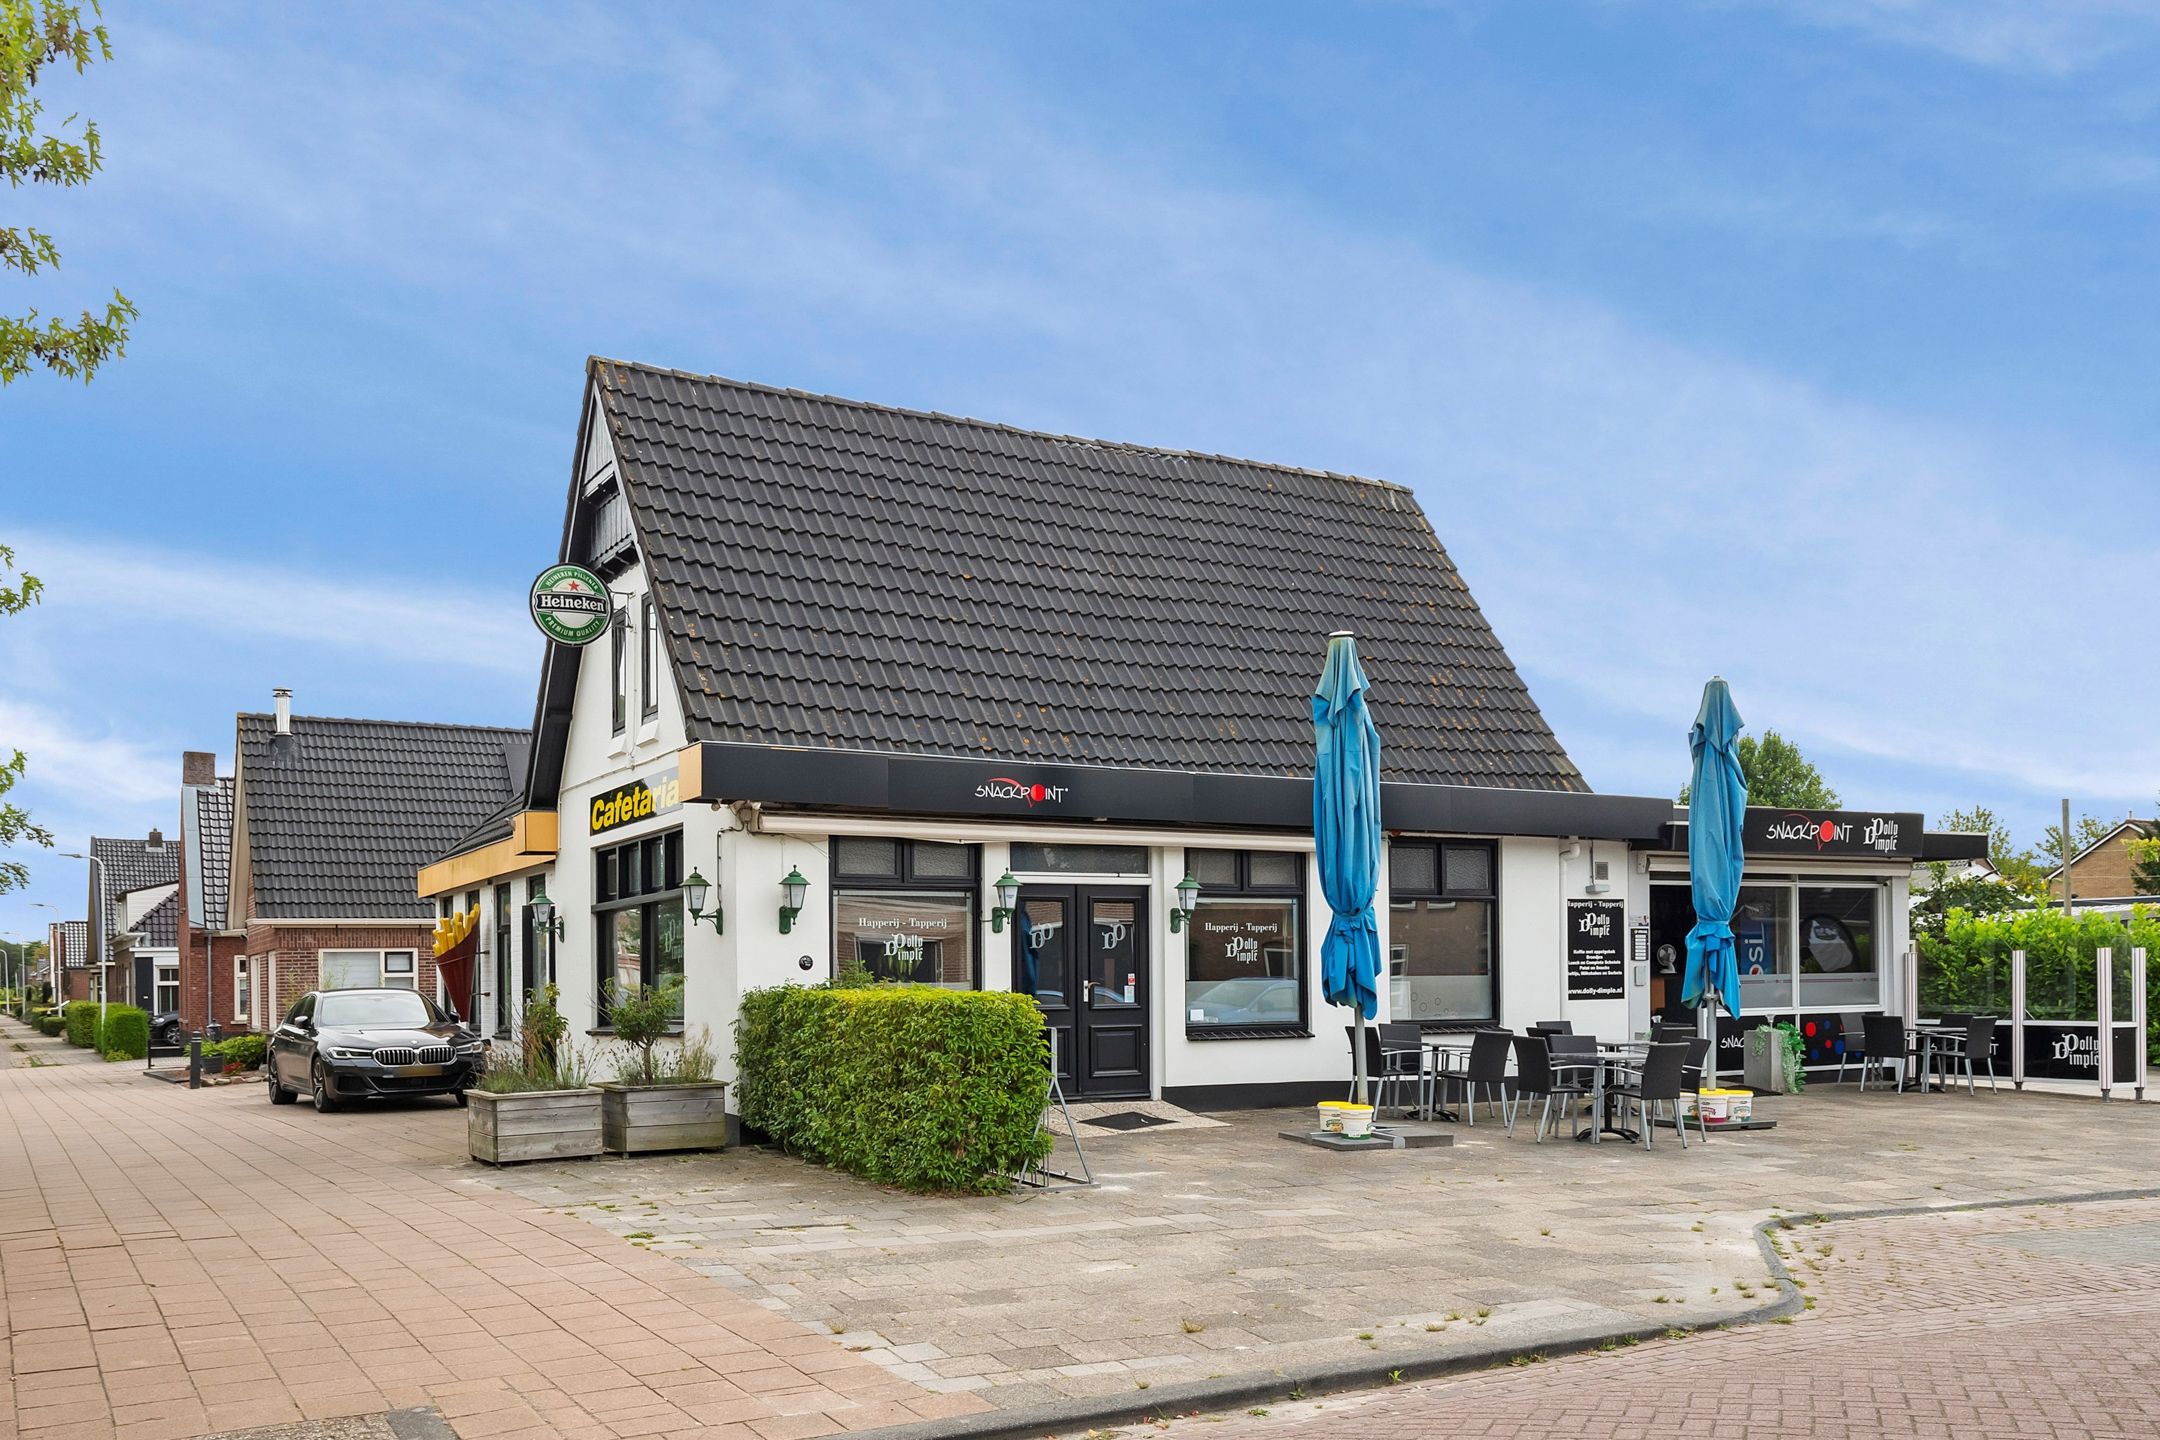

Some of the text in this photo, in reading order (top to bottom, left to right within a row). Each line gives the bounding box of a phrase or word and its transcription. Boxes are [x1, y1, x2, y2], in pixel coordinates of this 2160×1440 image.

[545, 570, 573, 587] HEINEKEN
[540, 594, 605, 612] Heineken
[545, 616, 600, 637] PREMIUM QUALITY
[592, 775, 679, 831] Cafetaria
[1871, 817, 1899, 838] Dolly
[858, 917, 900, 929] Happerij
[908, 917, 947, 929] Tapperij
[1205, 922, 1239, 933] Happerij
[1246, 922, 1278, 933] Tapperij
